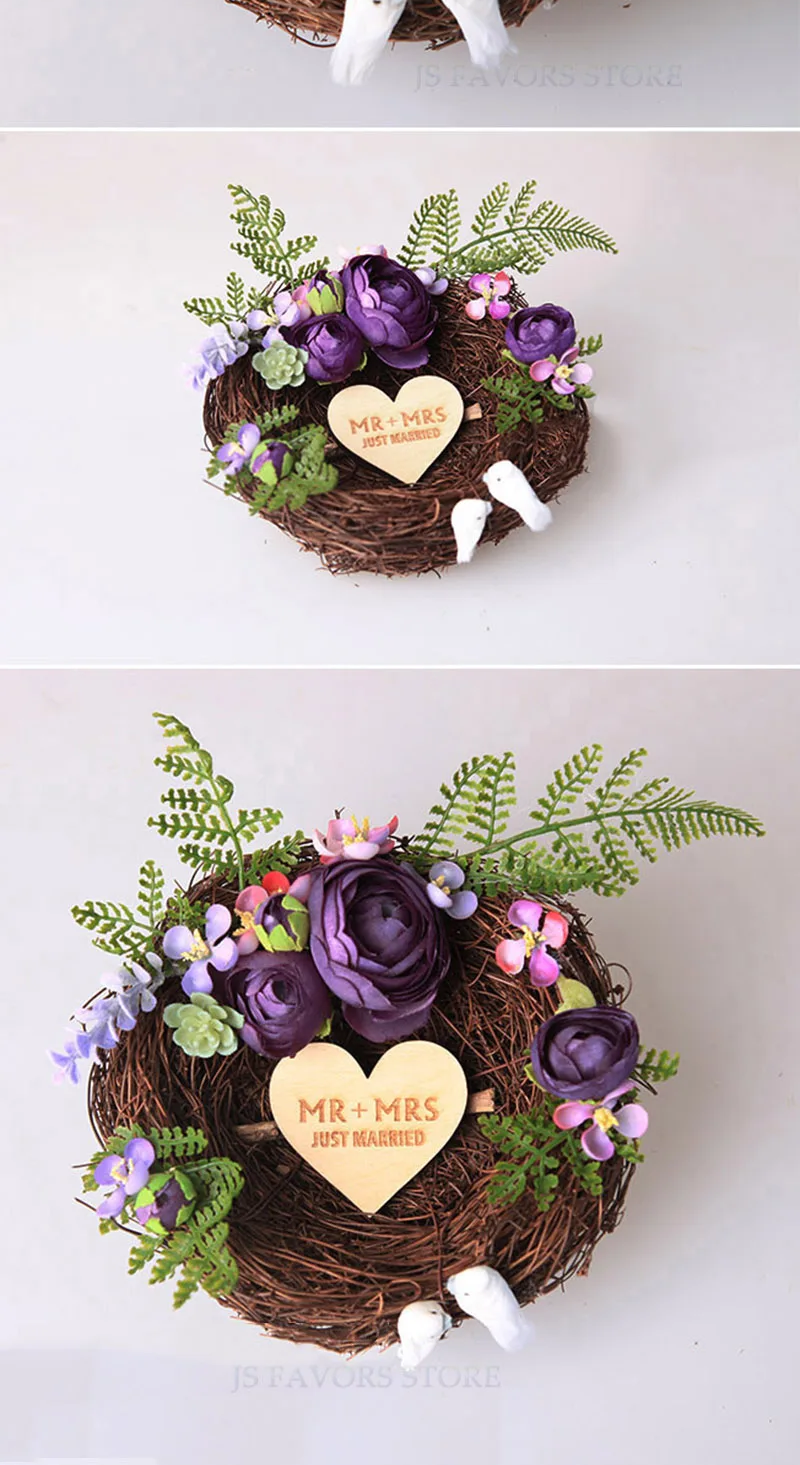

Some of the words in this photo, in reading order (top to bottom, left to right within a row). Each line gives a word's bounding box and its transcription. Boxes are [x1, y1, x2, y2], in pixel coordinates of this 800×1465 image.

[348, 415, 385, 435] MR
[400, 407, 449, 428] MRS
[362, 434, 389, 449] JUST
[390, 428, 442, 445] MARRIED
[298, 1098, 347, 1124] MR
[374, 1097, 440, 1123] MRS
[311, 1130, 349, 1148] JUST
[352, 1129, 426, 1147] MARRIED
